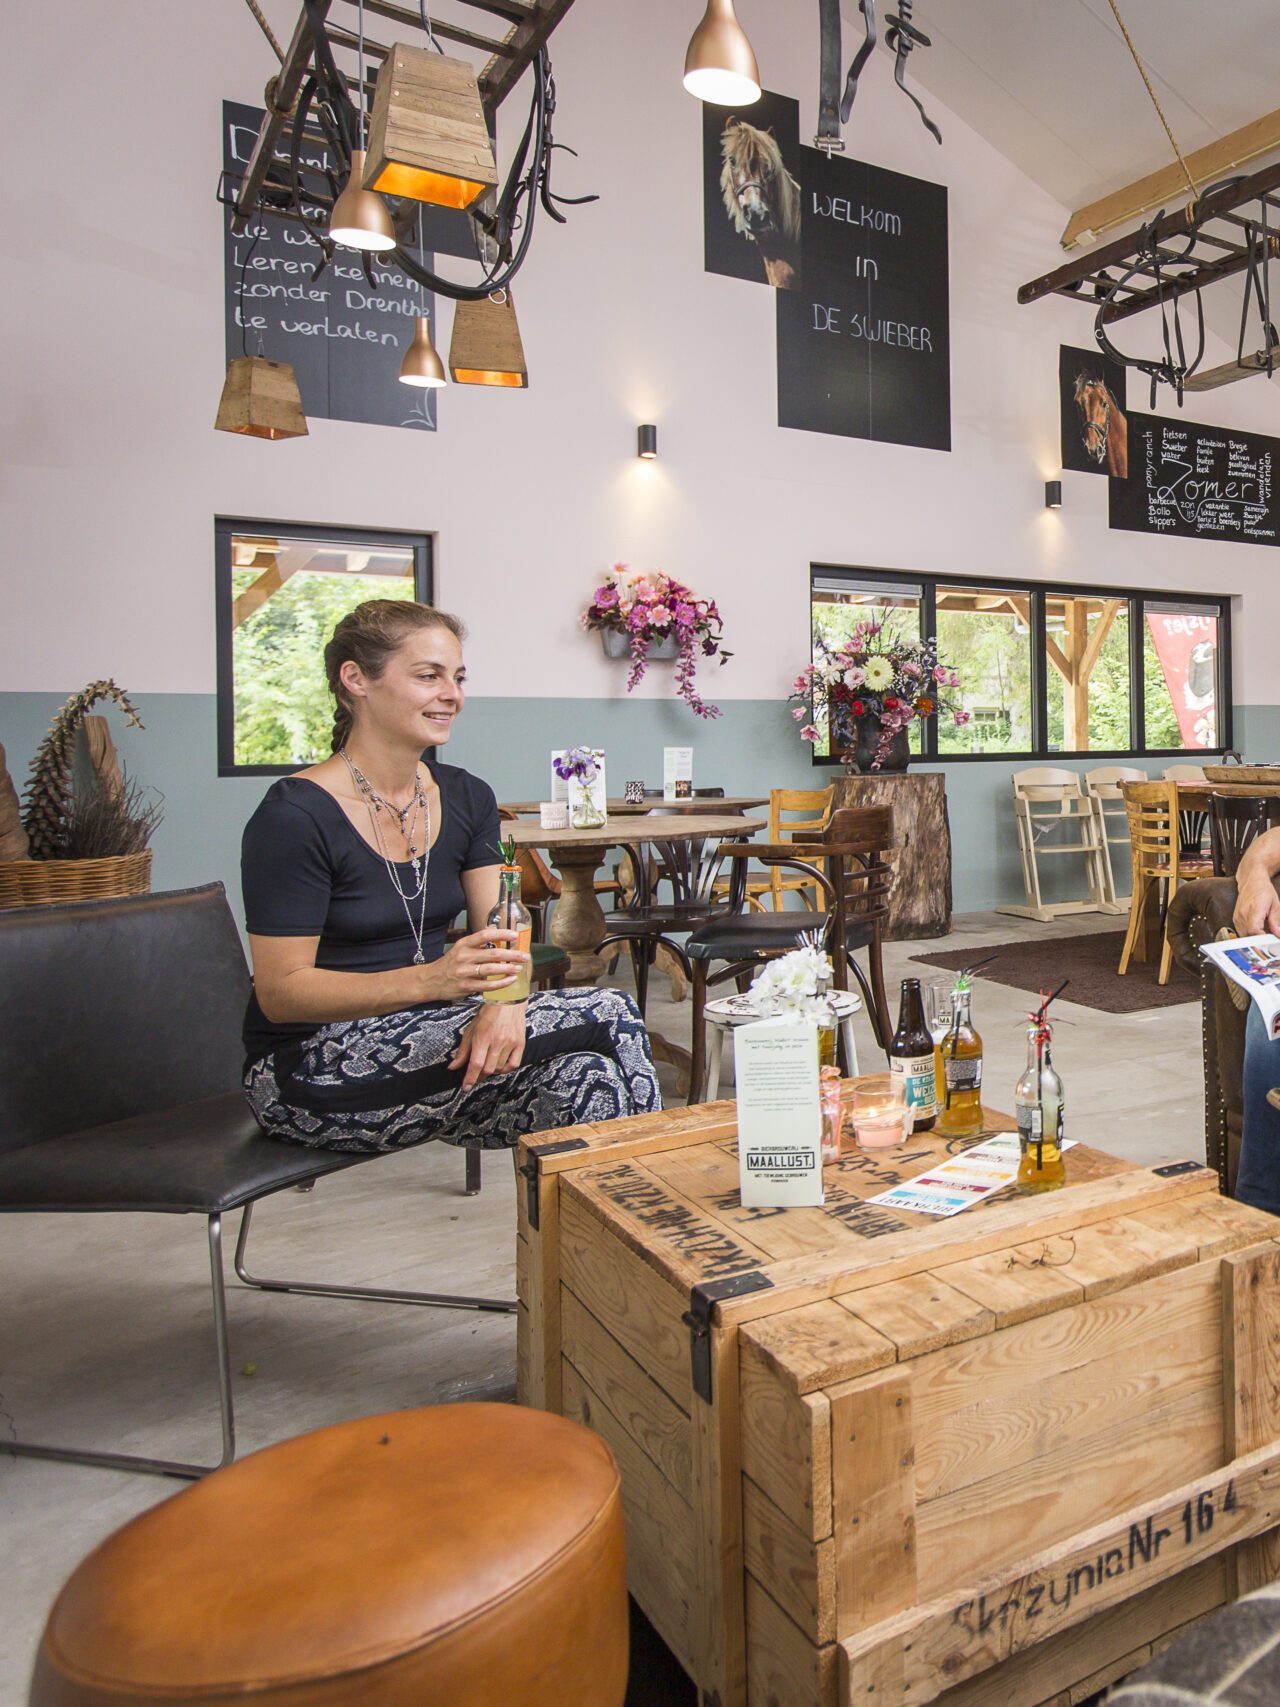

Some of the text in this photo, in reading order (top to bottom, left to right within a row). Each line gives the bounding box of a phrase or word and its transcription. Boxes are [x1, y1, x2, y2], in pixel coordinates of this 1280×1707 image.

[813, 192, 901, 236] WELKOM
[234, 281, 331, 302] zonder
[235, 306, 268, 328] te
[813, 304, 932, 352] DE SWIEBER
